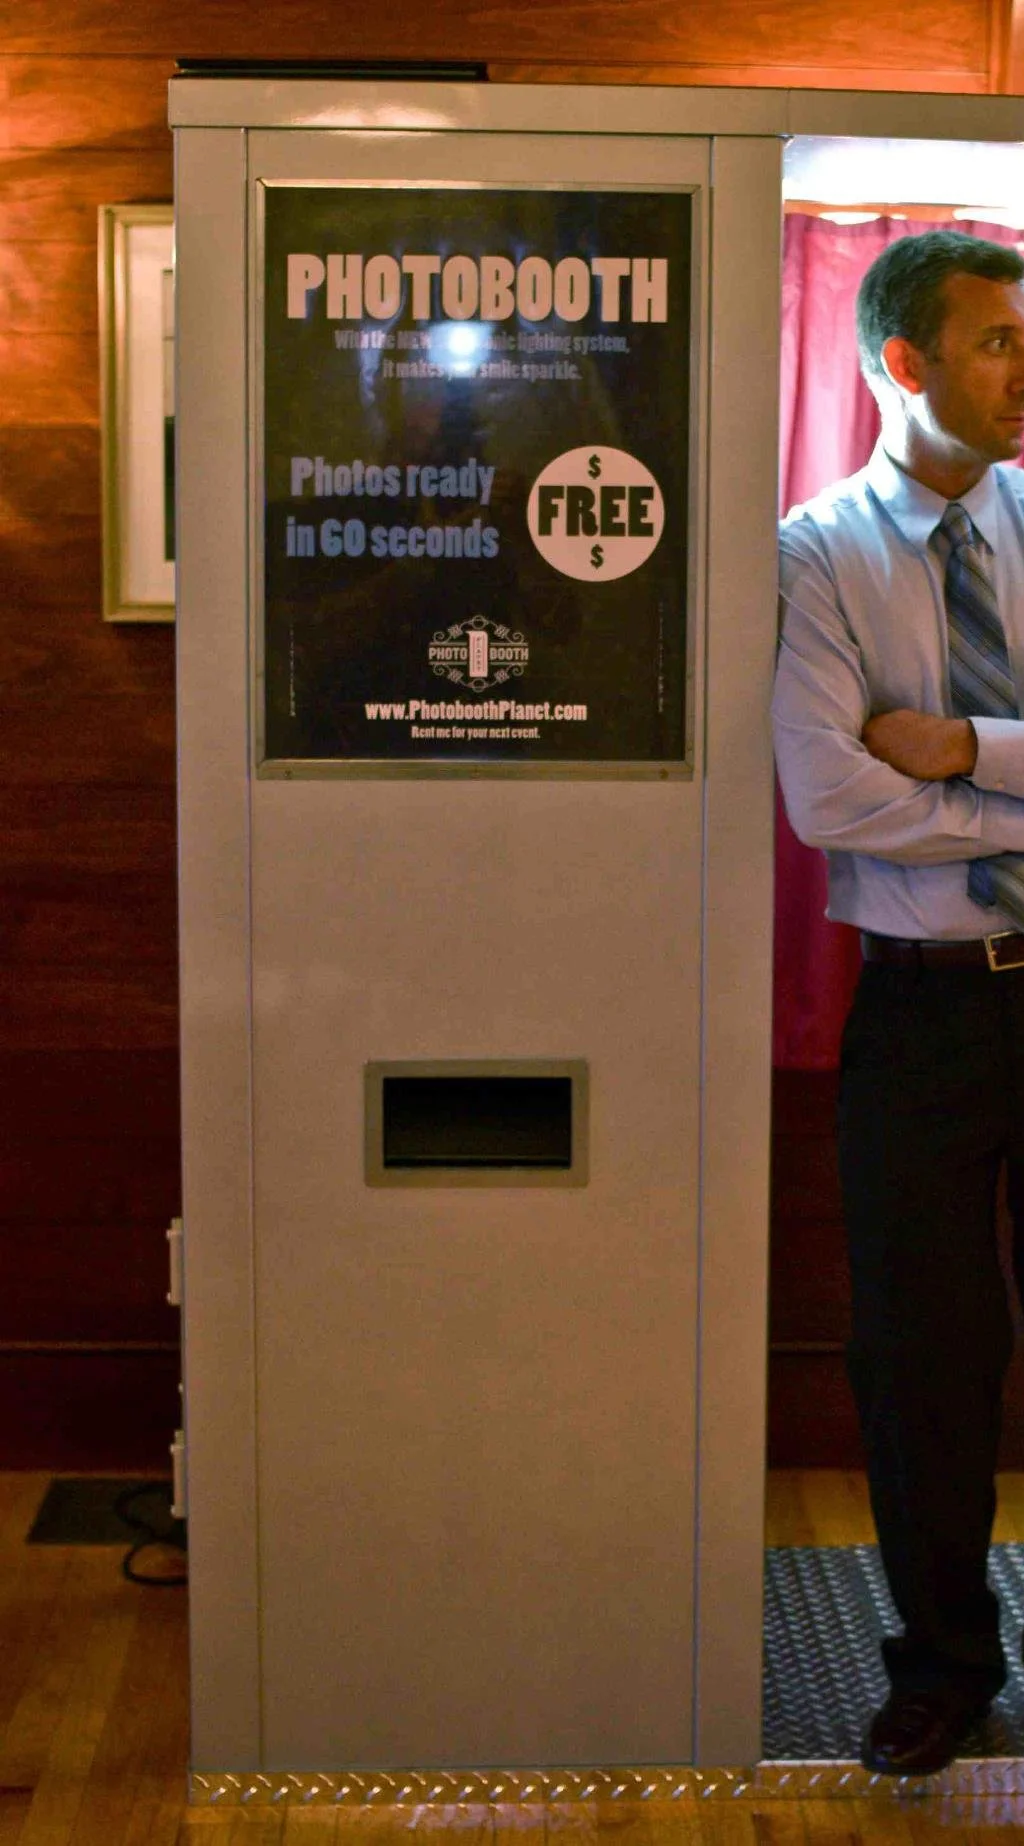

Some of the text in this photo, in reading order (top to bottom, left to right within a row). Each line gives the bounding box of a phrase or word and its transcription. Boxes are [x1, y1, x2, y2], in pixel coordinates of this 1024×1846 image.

[287, 254, 668, 323] PHOTOBOOTH
[517, 332, 571, 354] lighting
[573, 334, 630, 355] system,
[383, 359, 394, 378] it
[396, 360, 445, 378] makes
[480, 359, 520, 379] smile
[522, 360, 582, 382] sparkle.
[588, 454, 602, 480] $
[291, 456, 495, 505] Photos ready
[538, 485, 654, 537] FREE
[286, 516, 499, 558] in 60 seconds
[590, 544, 604, 569] $
[428, 647, 529, 660] PHOTO BOOTH
[365, 700, 588, 721] www.PhotoboothPlanet.com
[411, 726, 541, 741] Rent me for your next event.
